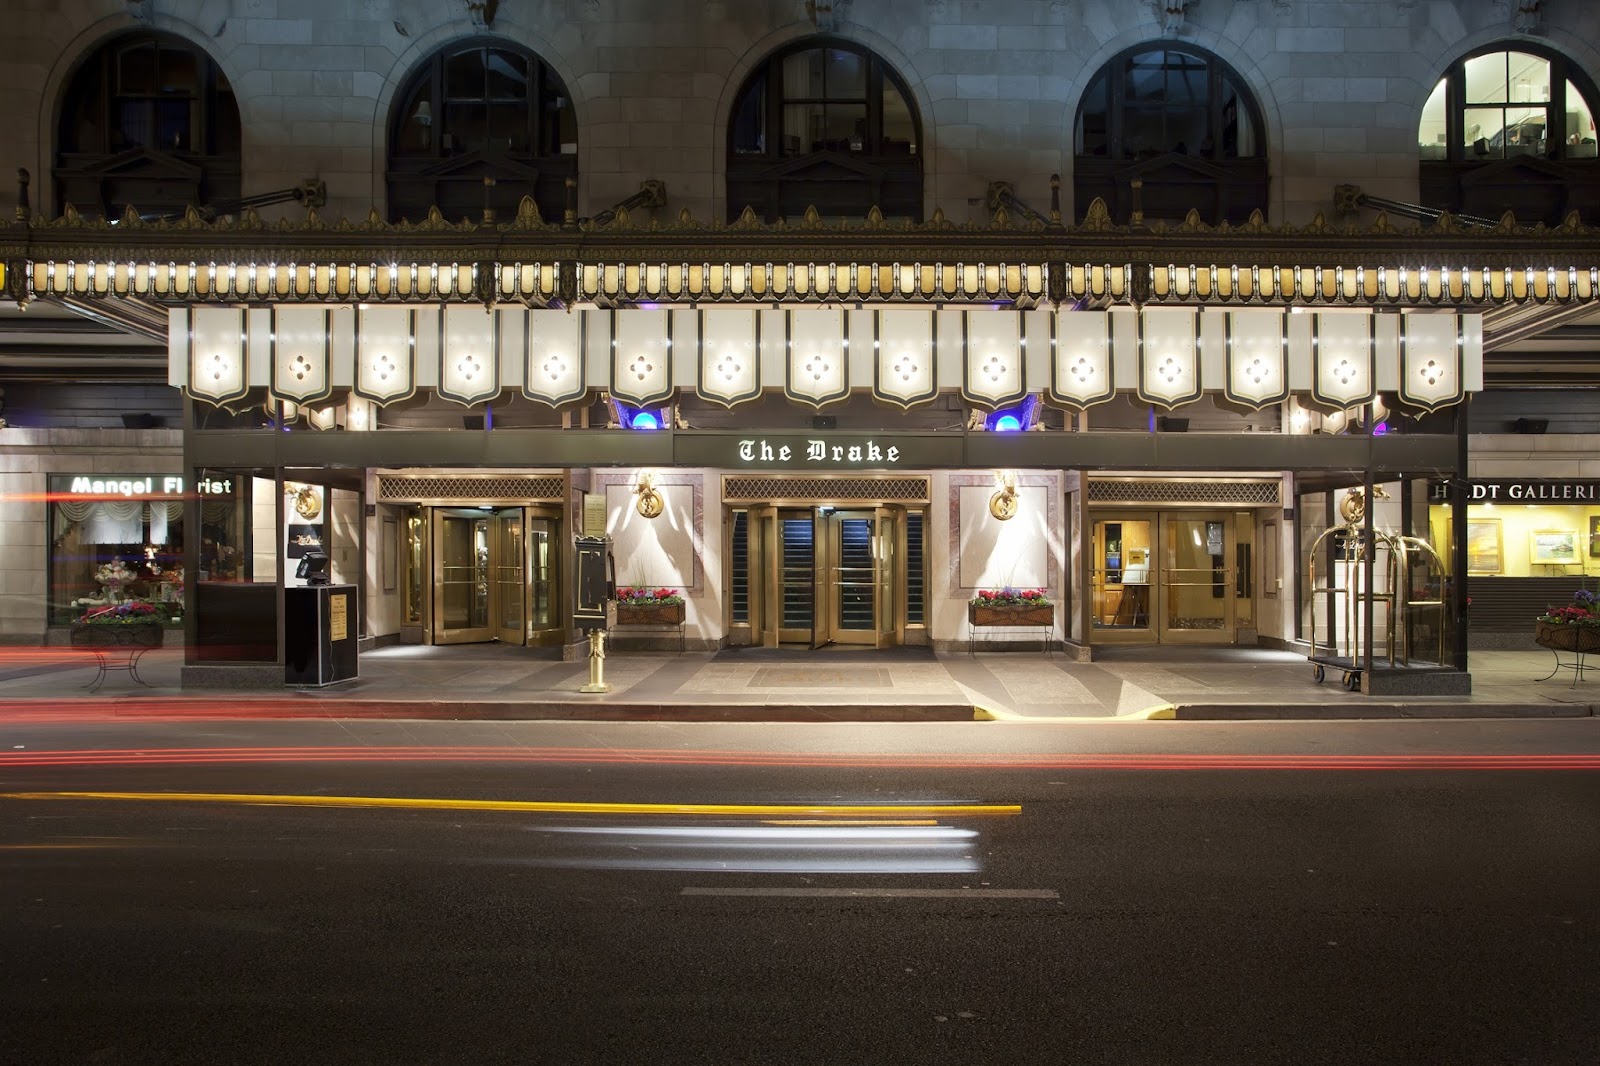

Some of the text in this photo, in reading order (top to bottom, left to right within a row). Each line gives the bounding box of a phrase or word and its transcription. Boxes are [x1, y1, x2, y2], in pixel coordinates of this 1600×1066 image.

[738, 439, 900, 463] The Drake
[70, 476, 232, 496] Mangel Flrist
[1434, 484, 1600, 499] HDT GALLERI
